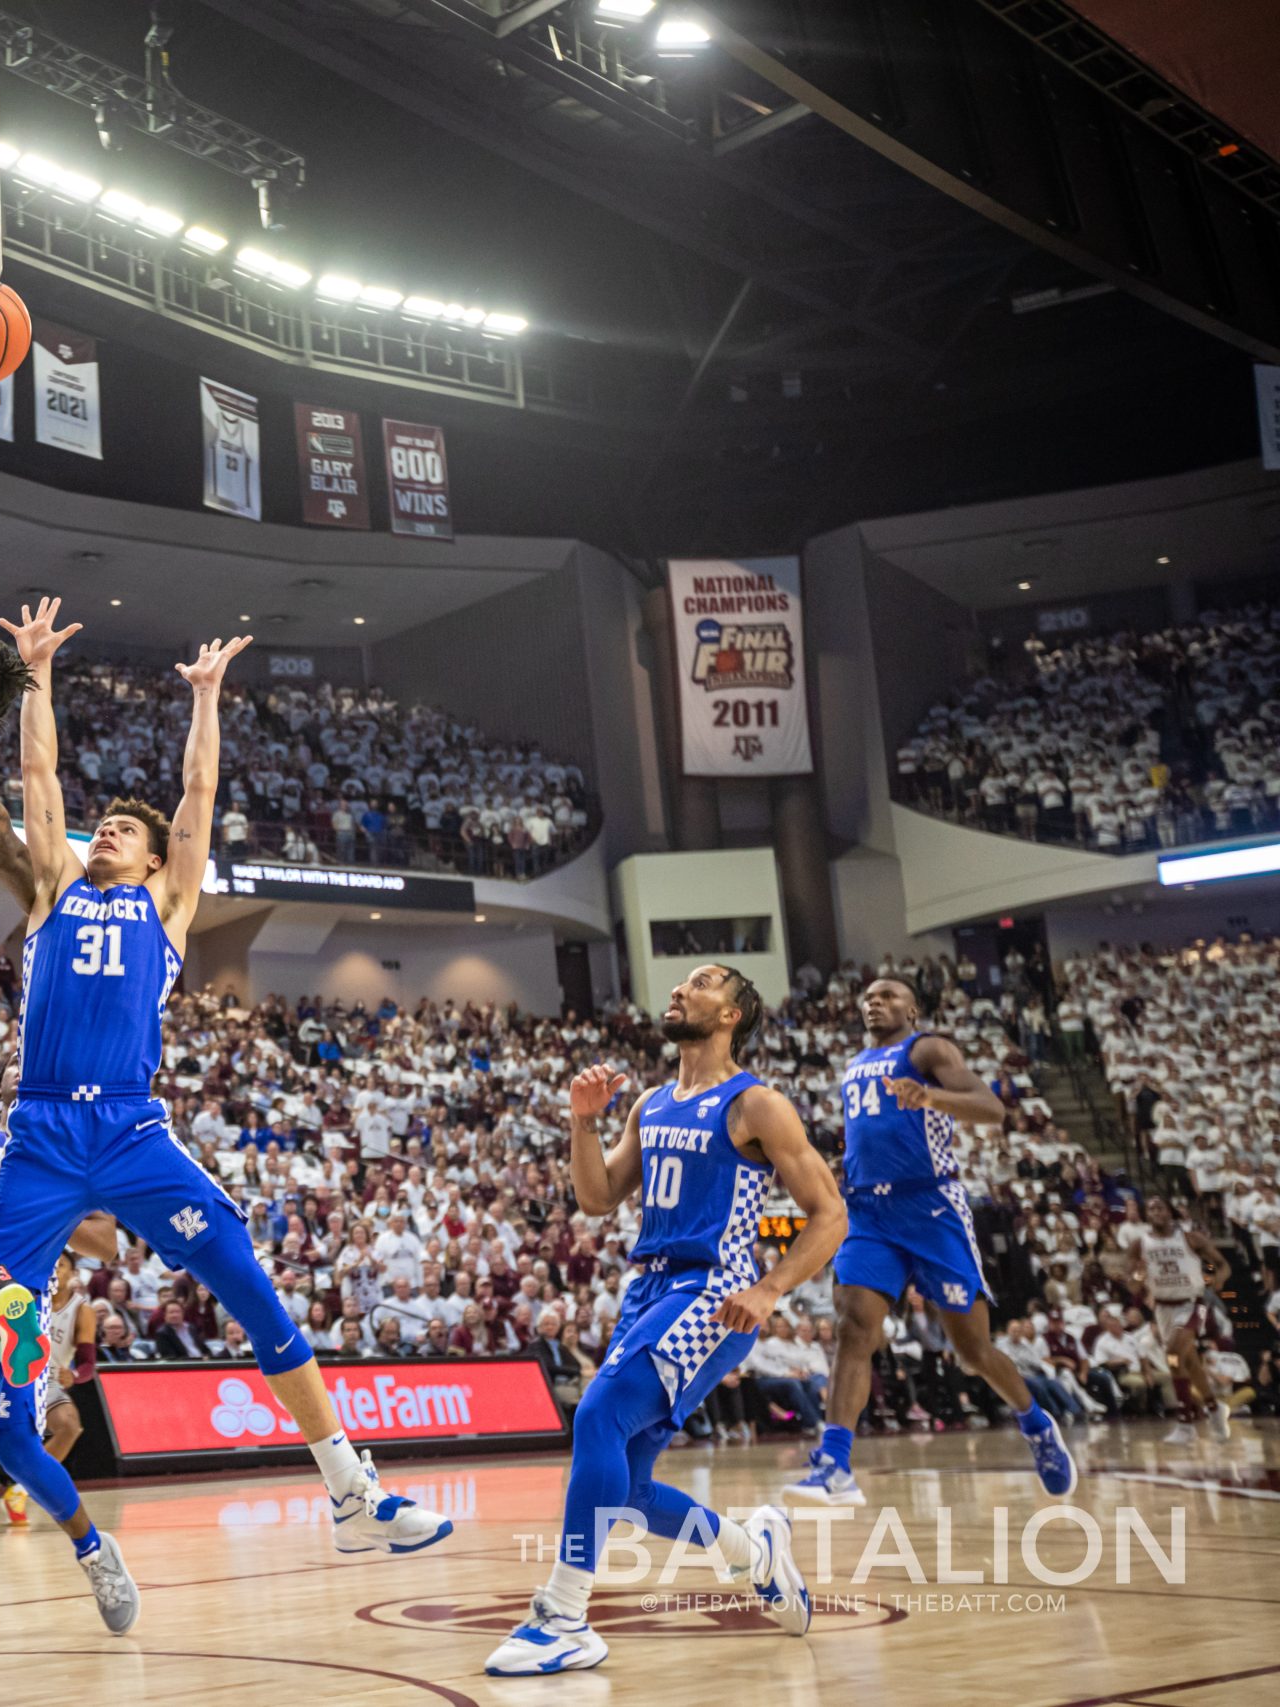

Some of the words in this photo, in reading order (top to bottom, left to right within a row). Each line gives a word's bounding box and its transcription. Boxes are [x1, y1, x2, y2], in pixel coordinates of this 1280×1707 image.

[46, 387, 89, 422] 2021
[311, 458, 354, 478] GARY
[391, 447, 444, 485] 800
[310, 475, 358, 495] BLAIR
[395, 489, 448, 517] WINS
[693, 575, 776, 594] NATIONAL
[684, 594, 789, 615] CHAMPIONS
[721, 625, 787, 650] FINAL
[269, 656, 313, 676] 209
[712, 699, 779, 728] 2011
[233, 879, 256, 893] THE
[301, 869, 328, 885] WITH
[328, 872, 348, 887] THE
[72, 924, 125, 976] 31
[846, 1079, 880, 1119] 34
[646, 1155, 683, 1210] 10
[279, 1375, 471, 1434] teFarm
